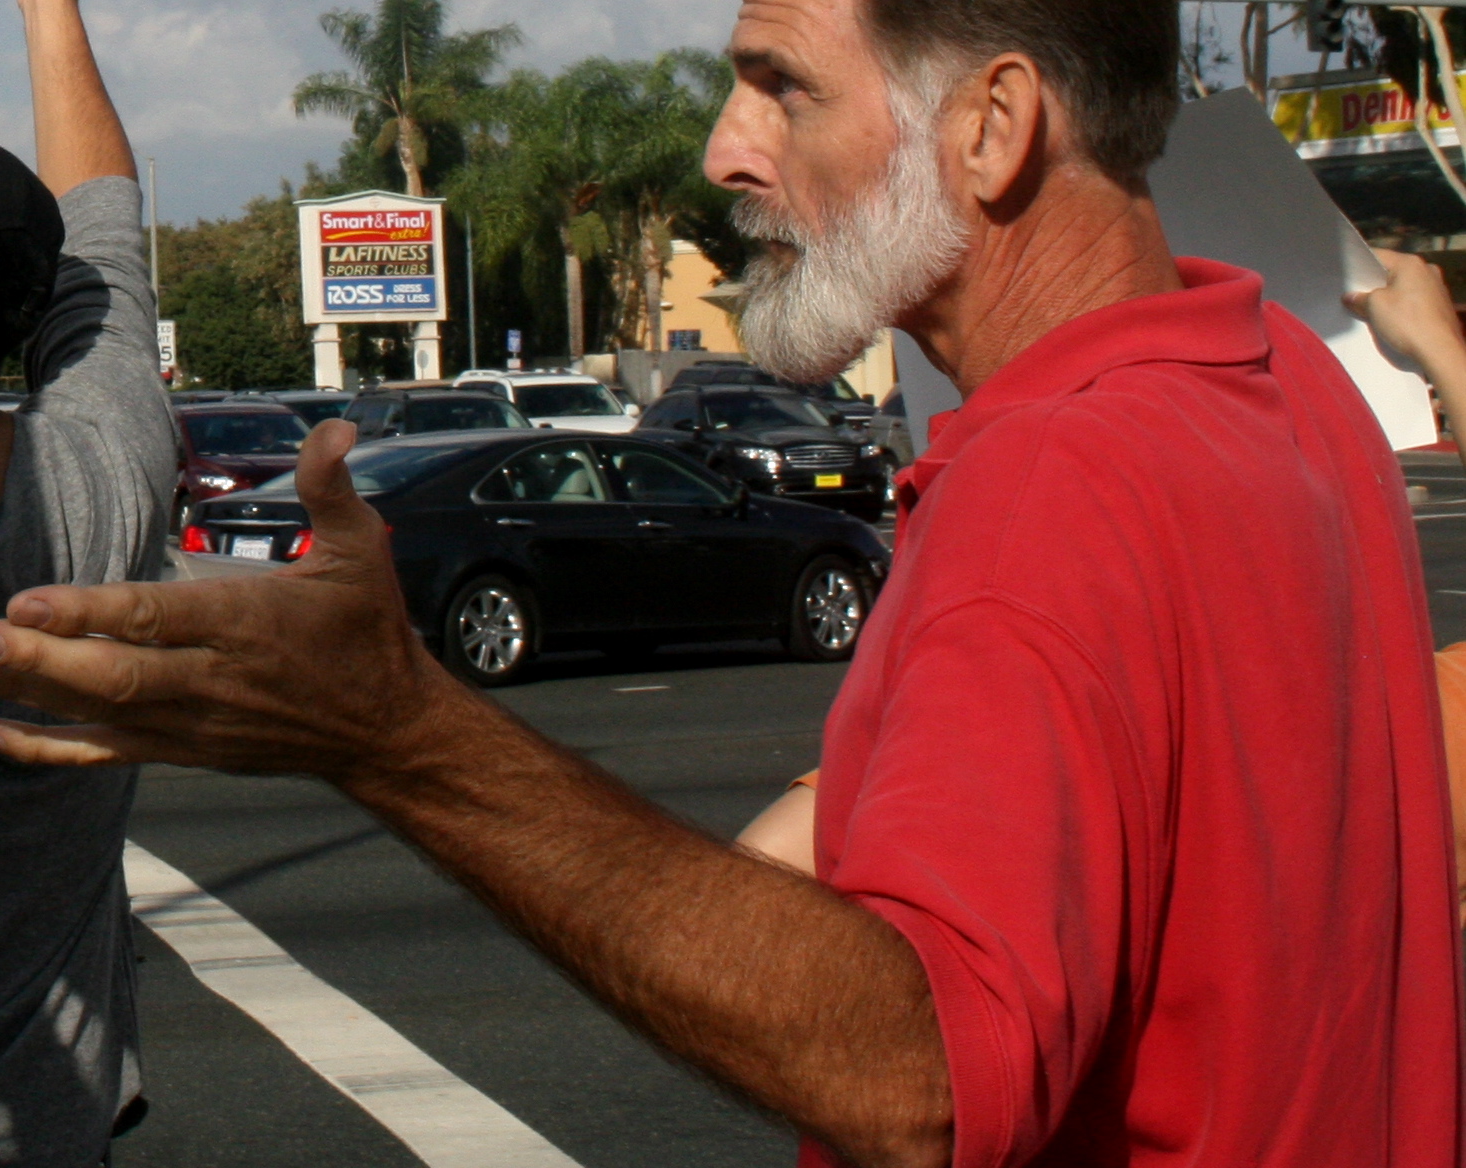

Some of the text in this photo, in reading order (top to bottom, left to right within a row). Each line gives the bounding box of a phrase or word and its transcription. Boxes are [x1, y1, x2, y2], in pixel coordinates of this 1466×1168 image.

[327, 263, 428, 277] SPORTS CLUBS
[328, 283, 423, 304] ROSS DRESS
